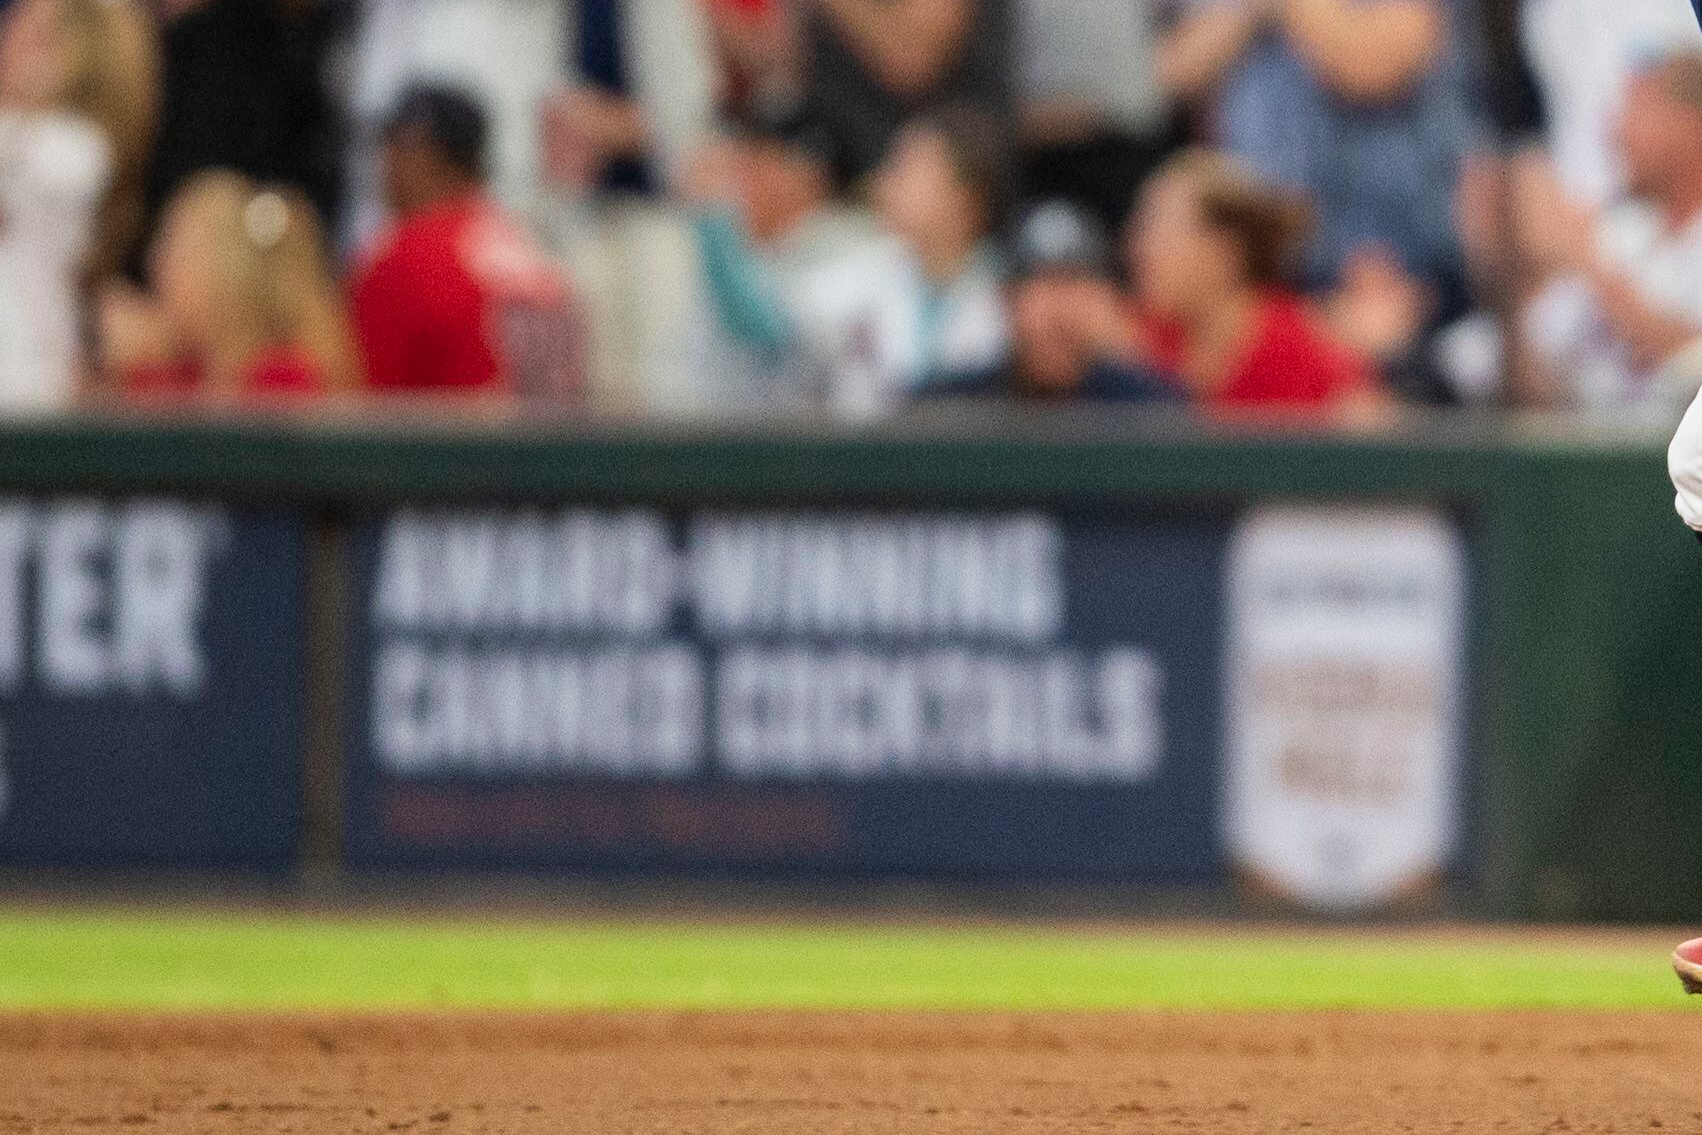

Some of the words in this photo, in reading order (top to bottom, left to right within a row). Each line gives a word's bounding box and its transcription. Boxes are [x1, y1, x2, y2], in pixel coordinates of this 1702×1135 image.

[378, 511, 1062, 636] AWARD-WINNING
[373, 643, 704, 770] CANNED
[714, 645, 1162, 776] COCKTAILS
